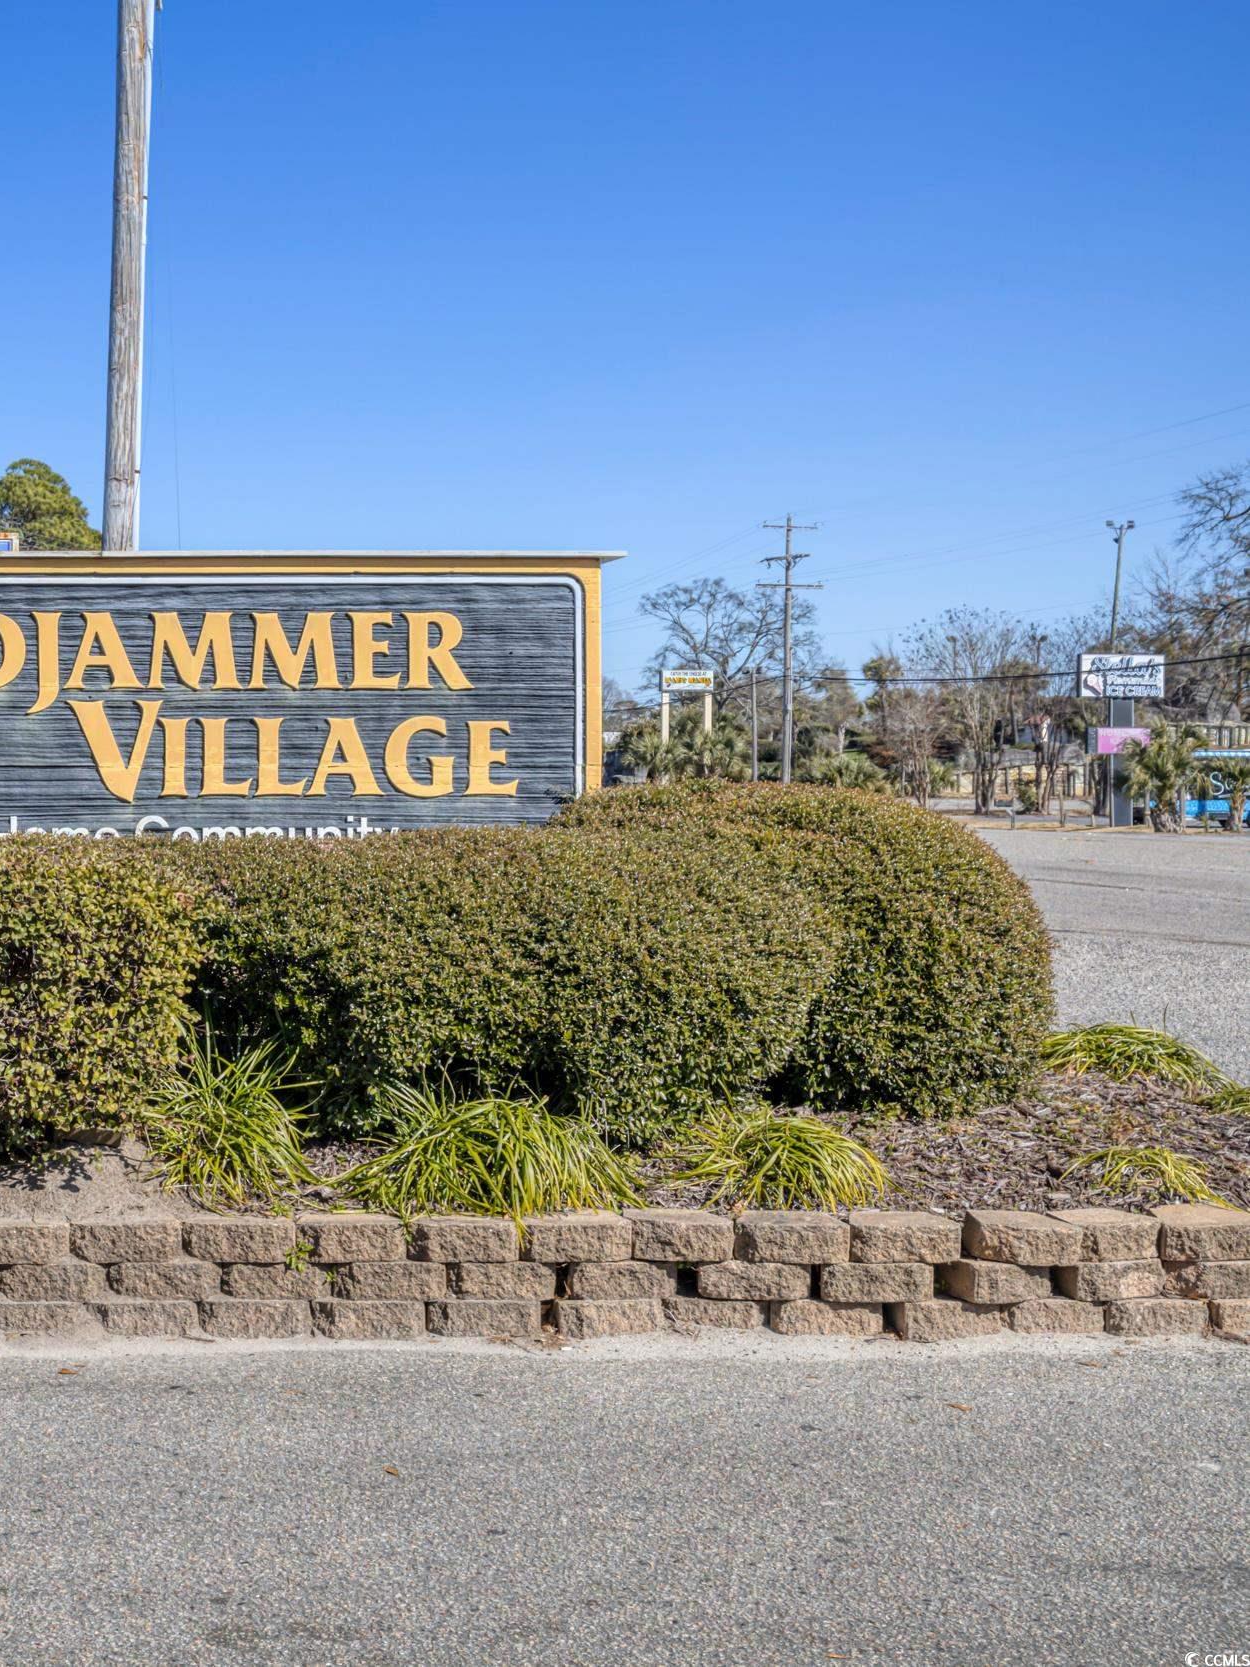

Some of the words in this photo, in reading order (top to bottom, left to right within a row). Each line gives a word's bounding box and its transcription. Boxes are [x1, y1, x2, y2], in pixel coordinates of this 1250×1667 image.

[1105, 686, 1124, 696] ICE
[1125, 686, 1162, 696] CREAM
[67, 699, 520, 804] VILLAGE
